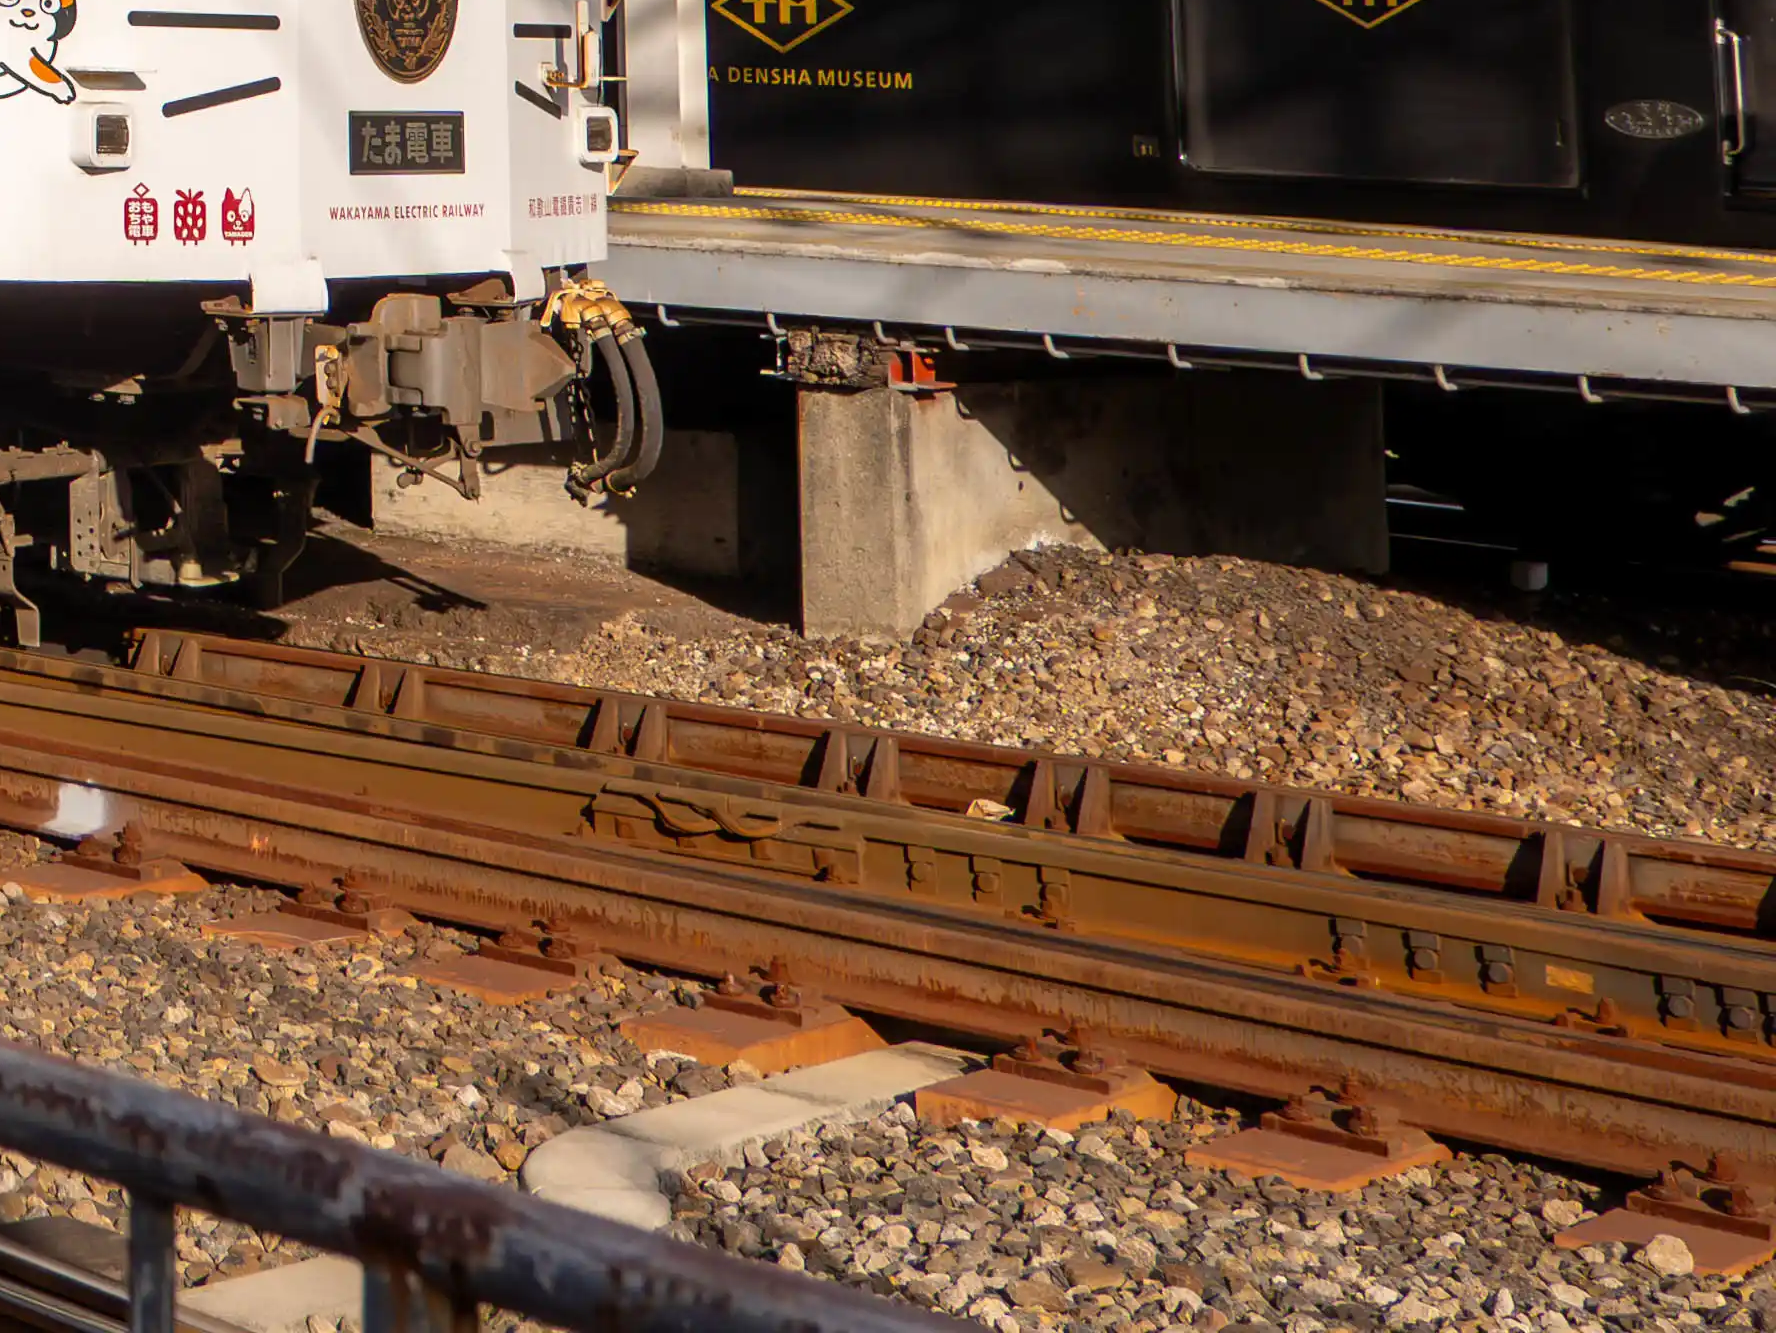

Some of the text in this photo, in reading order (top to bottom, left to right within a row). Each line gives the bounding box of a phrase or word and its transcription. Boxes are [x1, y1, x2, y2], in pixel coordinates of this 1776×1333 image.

[728, 67, 812, 86] DENSHA
[818, 69, 914, 90] MUSEUM
[361, 121, 454, 166] たま電車
[329, 202, 485, 221] WAKAYAMA ELECTRIC RAILWAY
